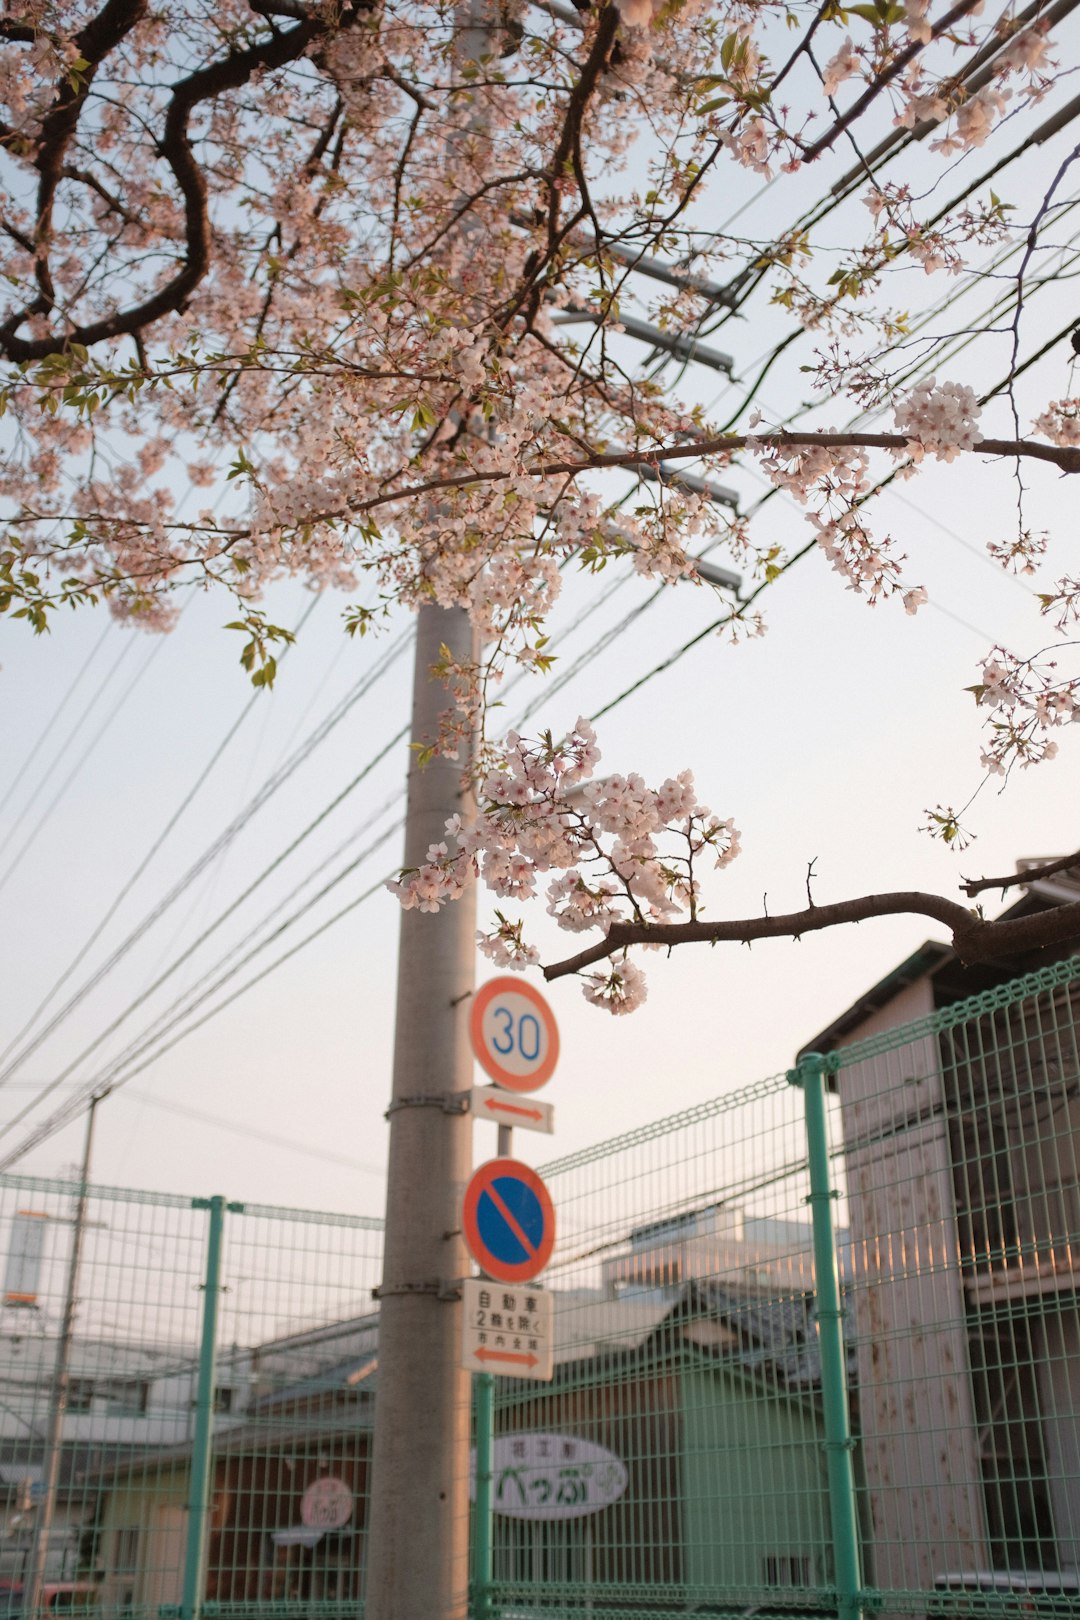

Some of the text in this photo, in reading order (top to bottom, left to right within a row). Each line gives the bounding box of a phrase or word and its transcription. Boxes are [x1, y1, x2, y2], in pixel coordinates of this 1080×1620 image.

[493, 1007, 539, 1061] 30
[478, 1289, 538, 1313] 自動車
